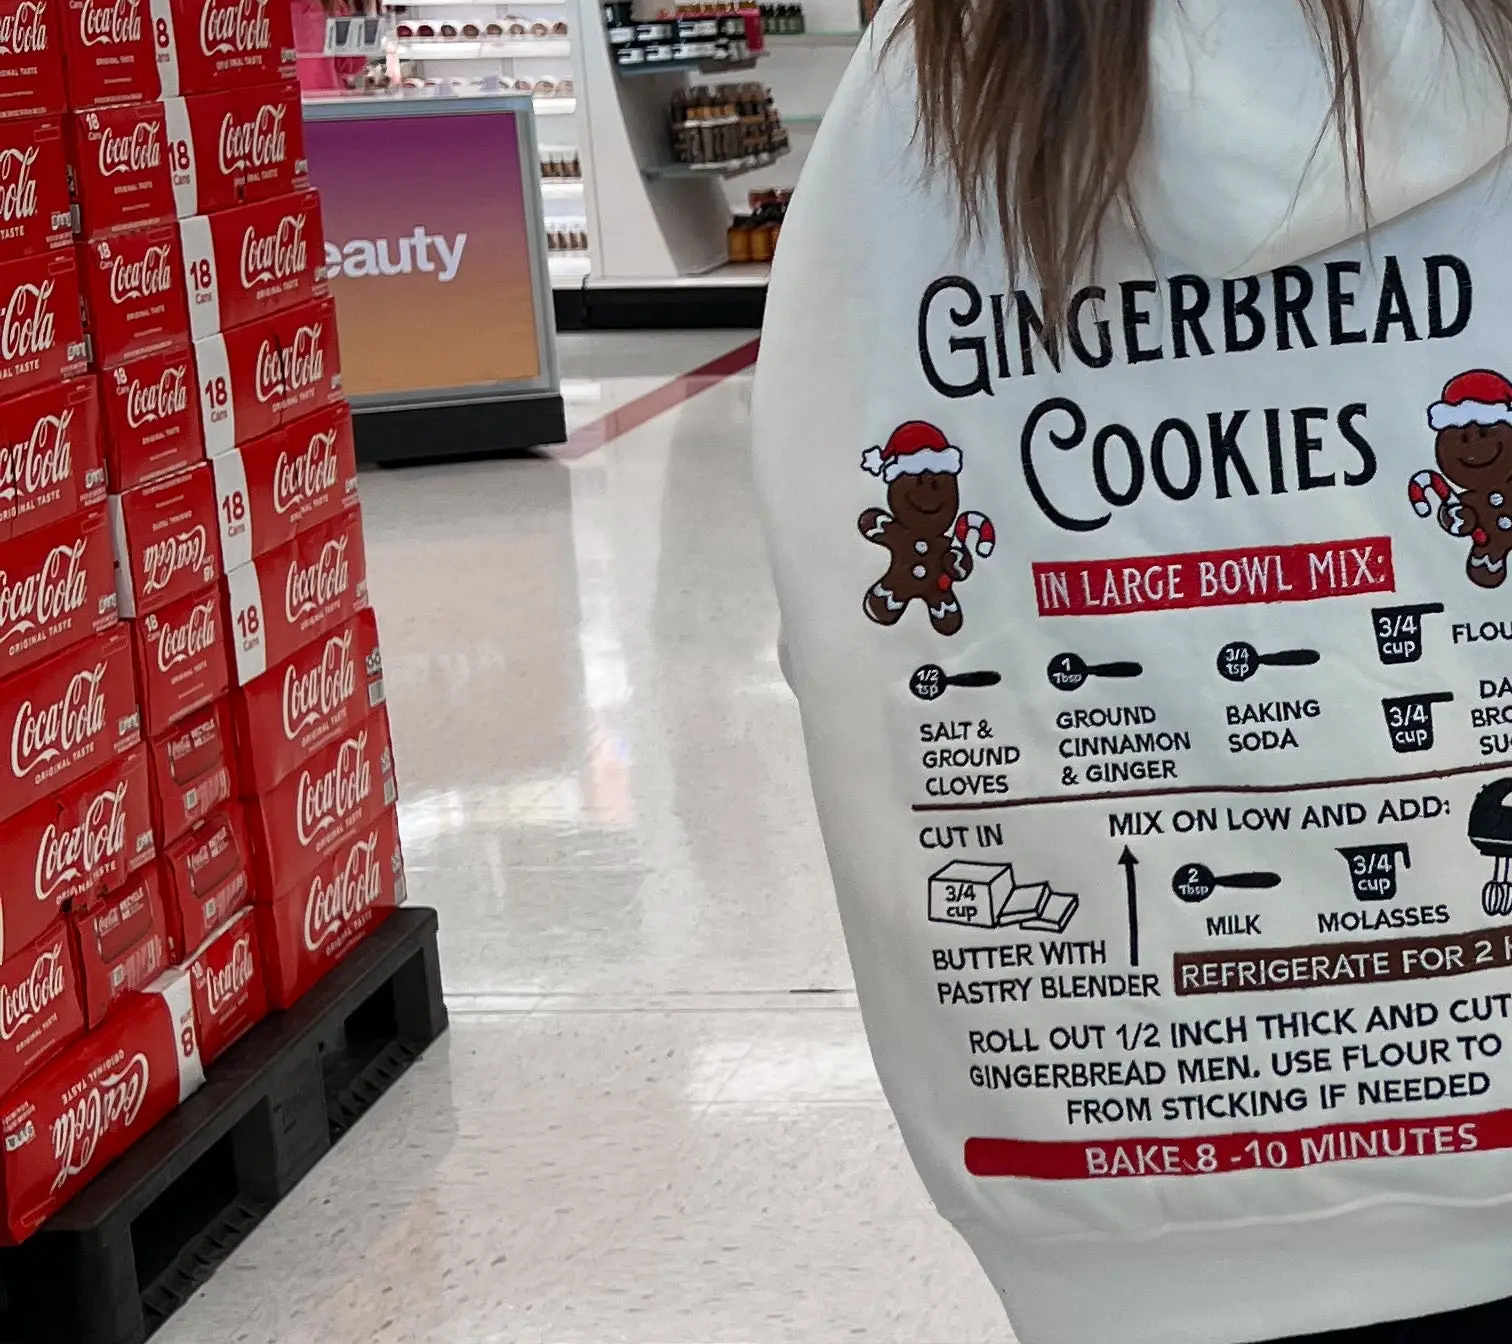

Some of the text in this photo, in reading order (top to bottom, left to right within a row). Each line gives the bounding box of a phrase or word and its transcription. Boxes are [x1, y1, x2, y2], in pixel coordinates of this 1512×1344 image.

[156, 17, 170, 49] 8
[169, 140, 190, 172] 18
[324, 226, 468, 282] eauty
[190, 259, 211, 291] 18
[916, 252, 1474, 399] GINGERBREAD
[16, 359, 40, 375] TASTE
[205, 377, 228, 409] 18
[1020, 396, 1377, 532] COOKIES
[222, 491, 245, 523] 18
[1040, 546, 1385, 609] IN LARGE BOWL MIX:
[237, 605, 260, 638] 18
[1378, 615, 1418, 638] 3/4
[9, 617, 73, 656] ORIGINAL TASTE
[1382, 640, 1416, 658] cup
[1061, 657, 1071, 671] 1
[1225, 648, 1249, 662] 3/4
[916, 669, 939, 682] 1/2
[1052, 672, 1082, 684] Tbsp
[1225, 662, 1249, 677] tsp
[917, 680, 940, 699] tsp
[1056, 705, 1157, 730] GROUND
[1225, 699, 1321, 726] BAKING
[1389, 704, 1429, 728] 3/4
[919, 718, 994, 743] SALT &
[1228, 727, 1299, 754] SODA
[1395, 729, 1428, 746] cup
[922, 745, 1021, 769] GROUND
[1058, 731, 1191, 759] CINNAMON
[35, 741, 95, 785] ORIGINAL TASTE
[1061, 759, 1178, 786] & GINGER
[925, 774, 1009, 797] CLOVES
[1108, 795, 1451, 838] MIX ON LOW AND ADD:
[919, 823, 1004, 849] CUT IN
[1188, 867, 1199, 884] 2
[1353, 853, 1392, 875] 3/4
[944, 882, 978, 905] 3/4
[1178, 883, 1209, 896] Tbsp
[1357, 878, 1391, 895] cup
[945, 903, 979, 922] cup
[1206, 914, 1262, 936] MILK
[1317, 904, 1451, 934] MOLASSES
[931, 939, 1107, 971] BUTTER WITH
[1181, 951, 1390, 989] REFRIGERATE
[1402, 945, 1465, 974] FOR
[1474, 940, 1494, 964] 2
[937, 973, 1161, 1005] PASTRY BLENDER
[967, 1027, 1040, 1054] ROLL
[1049, 1024, 1106, 1051] OUT
[1115, 1022, 1161, 1051] 1/2
[1170, 1015, 1248, 1049] INCH
[1255, 1007, 1358, 1040] THICK
[1365, 1002, 1439, 1033] AND
[1449, 992, 1512, 1024] CUT
[969, 1059, 1167, 1090] GINGERBREAD
[1177, 1054, 1261, 1085] MEN.
[1271, 1048, 1332, 1077] USE
[1342, 1038, 1451, 1072] FLOUR
[1456, 1033, 1502, 1061] TO
[61, 1078, 87, 1106] TASTE
[1067, 1071, 1491, 1125] FROM STICKING IF NEEDED
[1085, 1144, 1182, 1176] BAKE
[1196, 1143, 1218, 1172] 8
[1300, 1122, 1478, 1165] MINUTES
